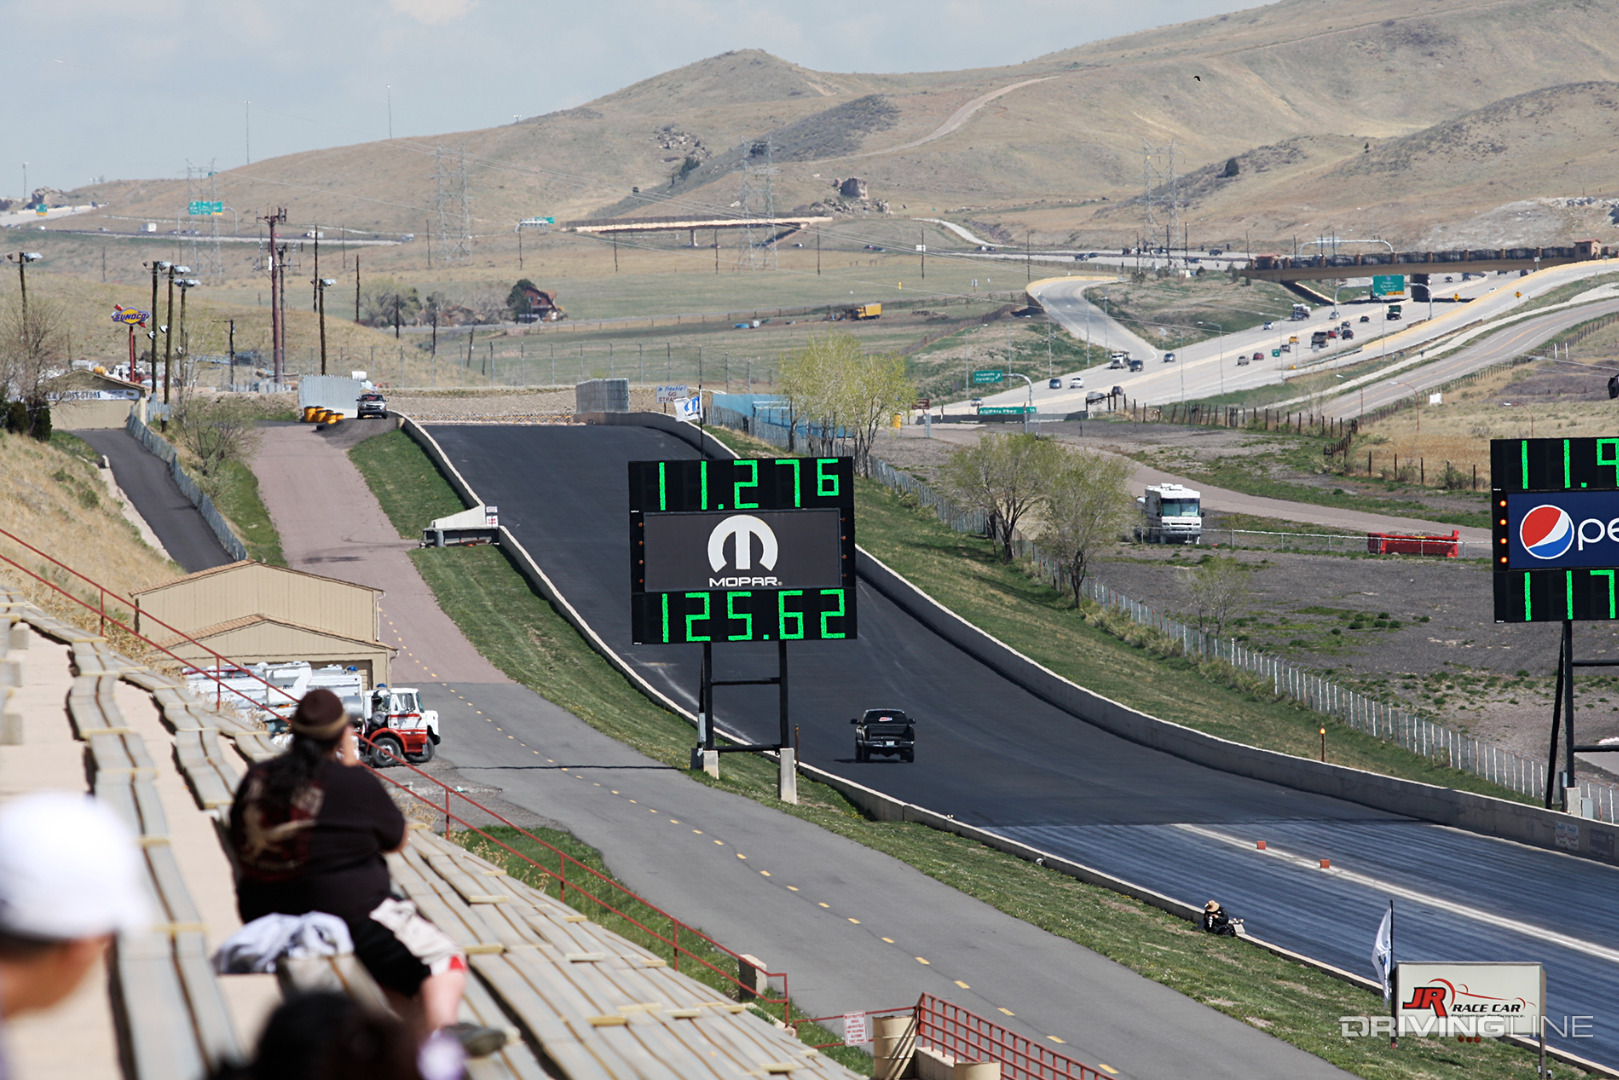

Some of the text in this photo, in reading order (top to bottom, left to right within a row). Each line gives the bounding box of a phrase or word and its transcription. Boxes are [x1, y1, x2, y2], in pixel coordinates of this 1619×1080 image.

[115, 313, 147, 321] SUNOCO
[658, 459, 840, 511] 11.276
[709, 576, 778, 588] MOPAR
[1524, 569, 1616, 621] 117
[661, 588, 846, 643] 125.62
[1402, 987, 1448, 1019] JR
[1452, 1003, 1521, 1012] RACE CAR
